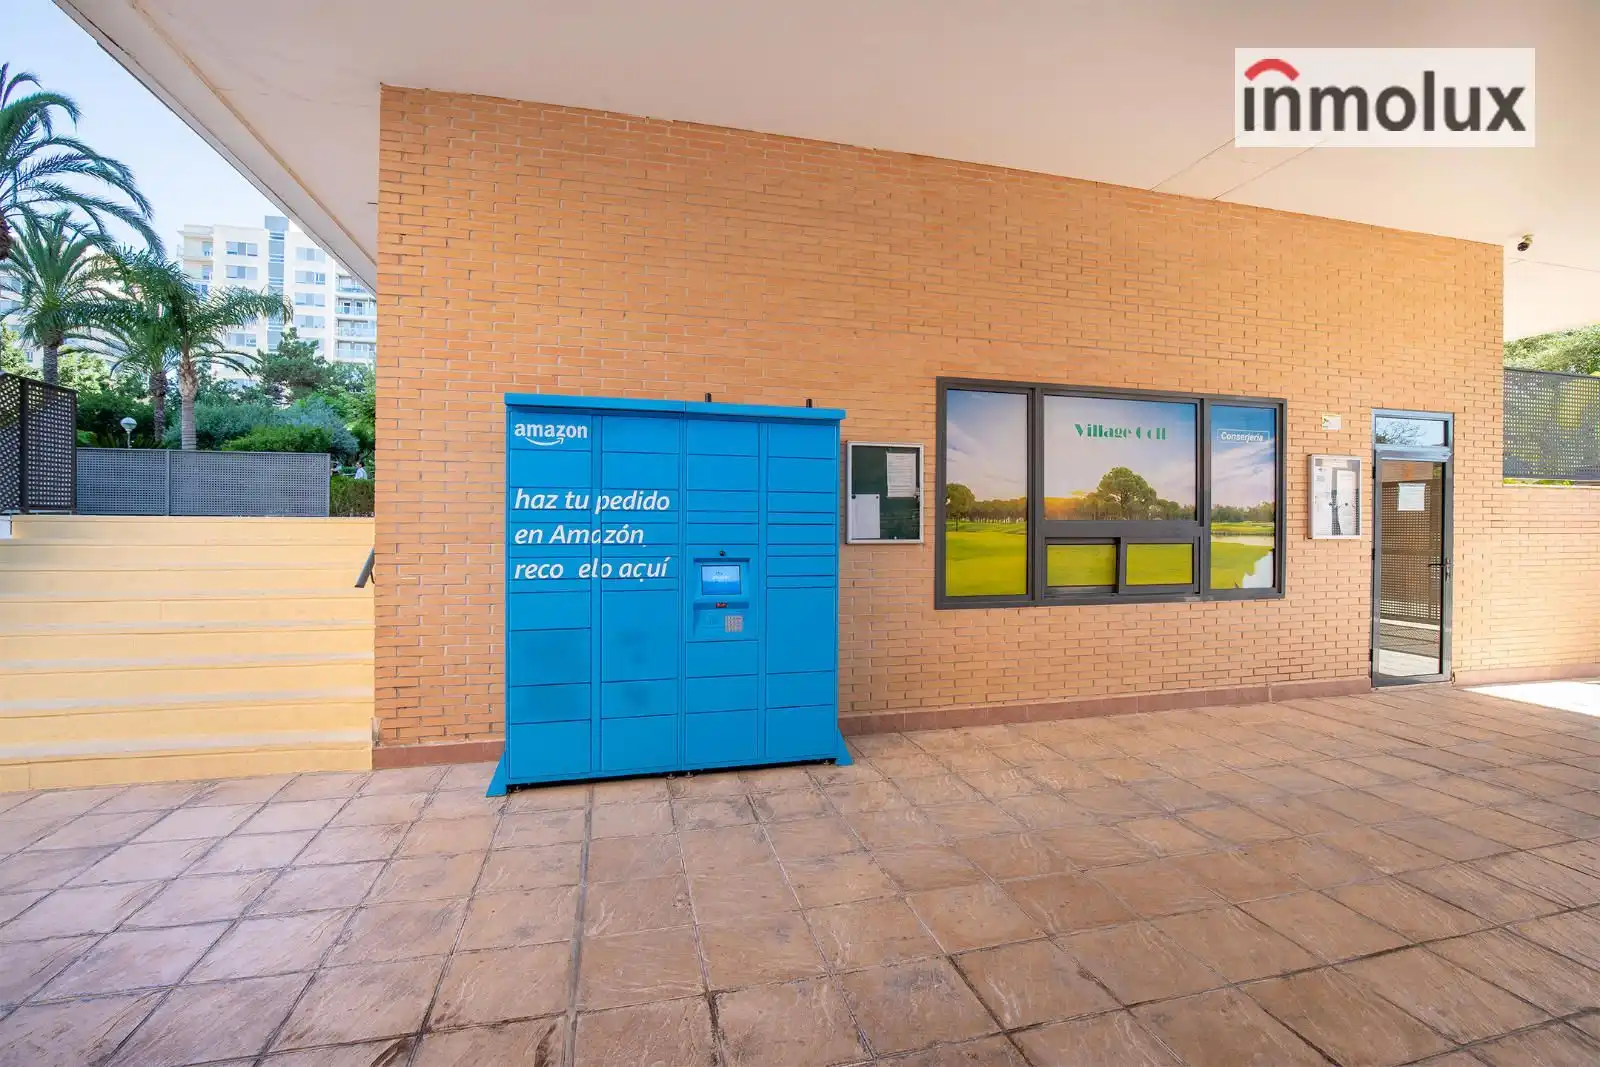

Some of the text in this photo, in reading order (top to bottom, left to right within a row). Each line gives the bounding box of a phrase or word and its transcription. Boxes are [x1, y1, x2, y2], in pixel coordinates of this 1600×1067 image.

[514, 423, 588, 439] amazon
[1073, 423, 1133, 438] Village
[514, 487, 670, 515] haz tu pedido
[514, 527, 544, 545] en
